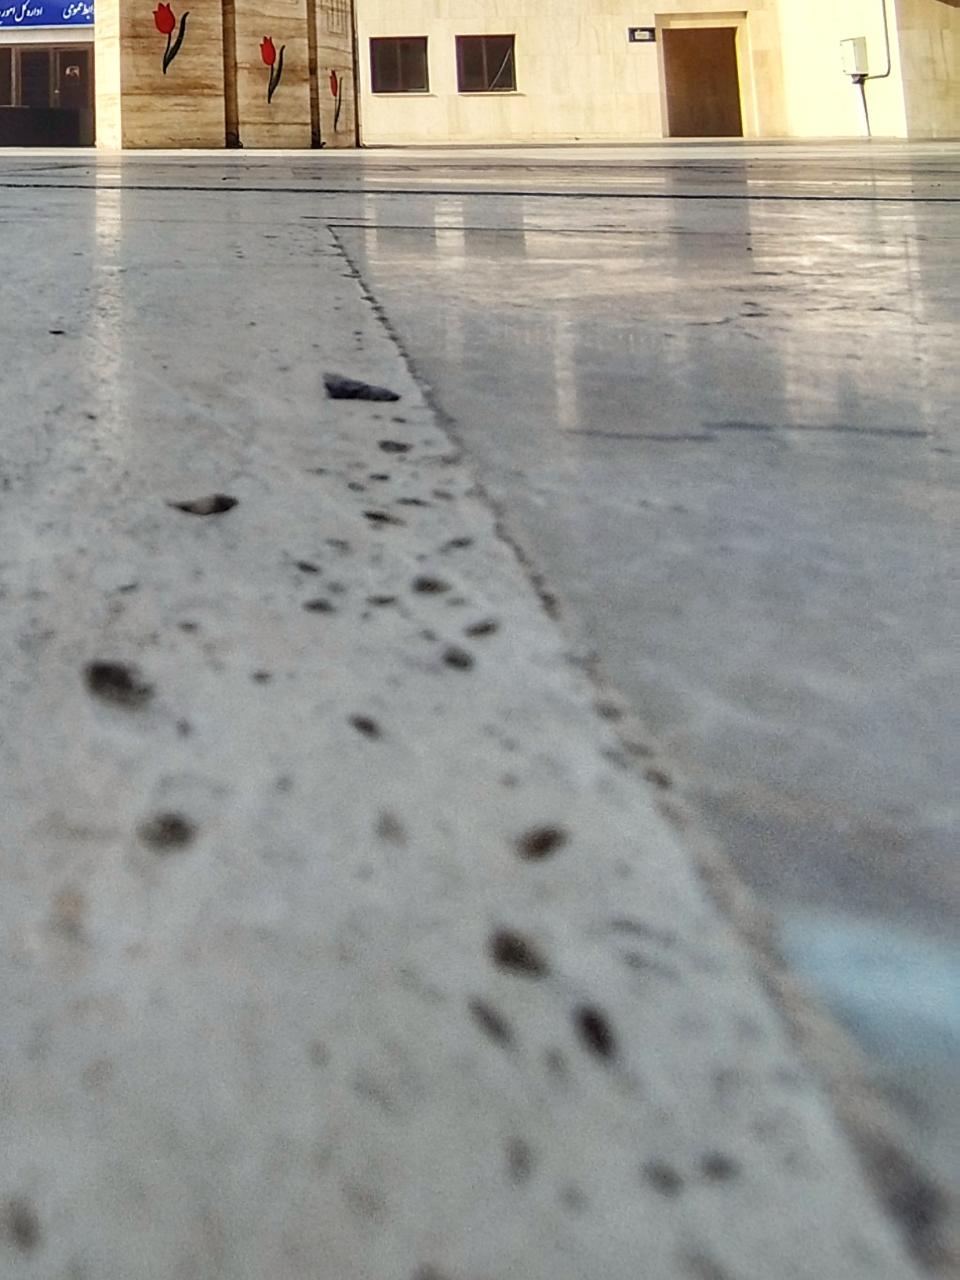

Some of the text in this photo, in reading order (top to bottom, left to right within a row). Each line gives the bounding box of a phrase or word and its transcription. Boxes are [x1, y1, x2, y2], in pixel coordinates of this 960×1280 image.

[1, 7, 15, 18] امور
[26, 7, 43, 17] اداره
[63, 2, 83, 19] عمومی
